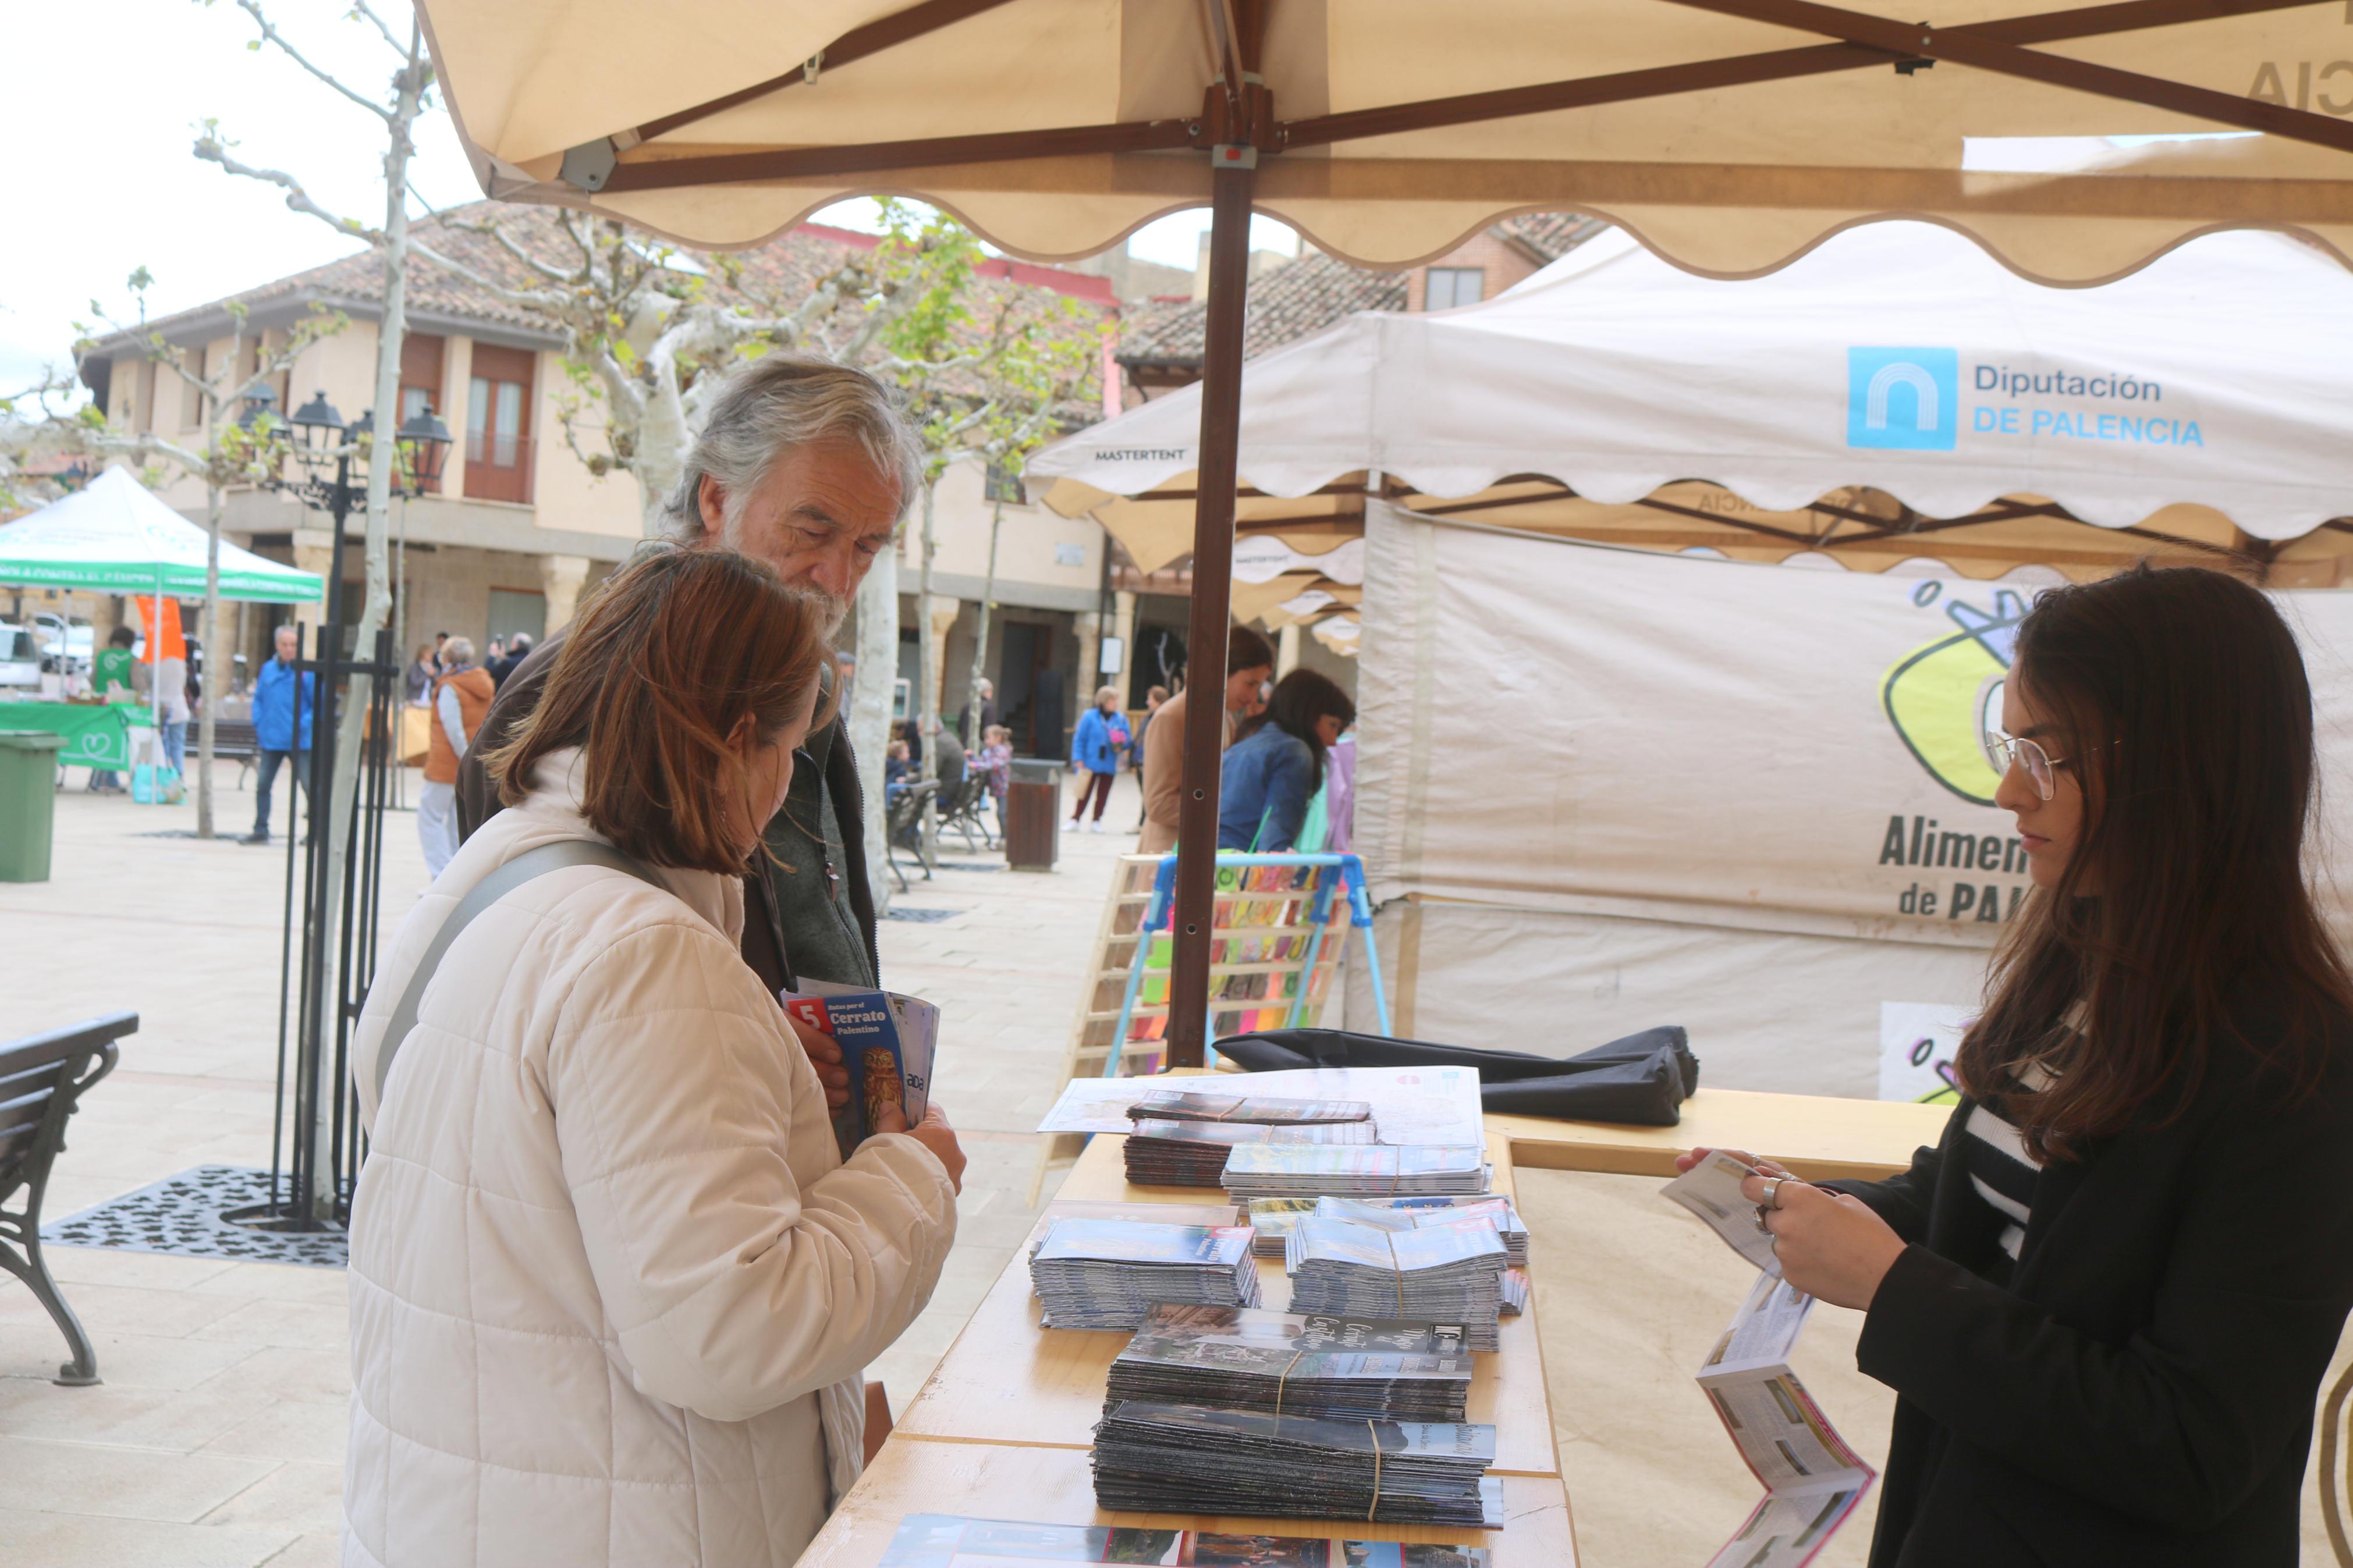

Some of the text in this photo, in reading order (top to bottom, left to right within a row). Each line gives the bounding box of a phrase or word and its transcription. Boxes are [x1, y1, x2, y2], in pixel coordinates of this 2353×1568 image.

[1975, 365, 2161, 401] Diputación
[1973, 407, 2204, 447] DE PALENCIA
[1095, 449, 1186, 461] MASTERTENT
[1879, 815, 2029, 874] Alimen
[1899, 882, 1937, 915] de
[799, 1005, 821, 1029] 5
[830, 1011, 886, 1024] Cerrato
[837, 1026, 880, 1035] Palentino
[1207, 1238, 1230, 1261] Cerrato
[1303, 1317, 1340, 1351] Castellano
[1337, 1323, 1373, 1349] Cerrato
[1392, 1328, 1426, 1350] Museo
[1453, 1424, 1481, 1455] Baltanás
